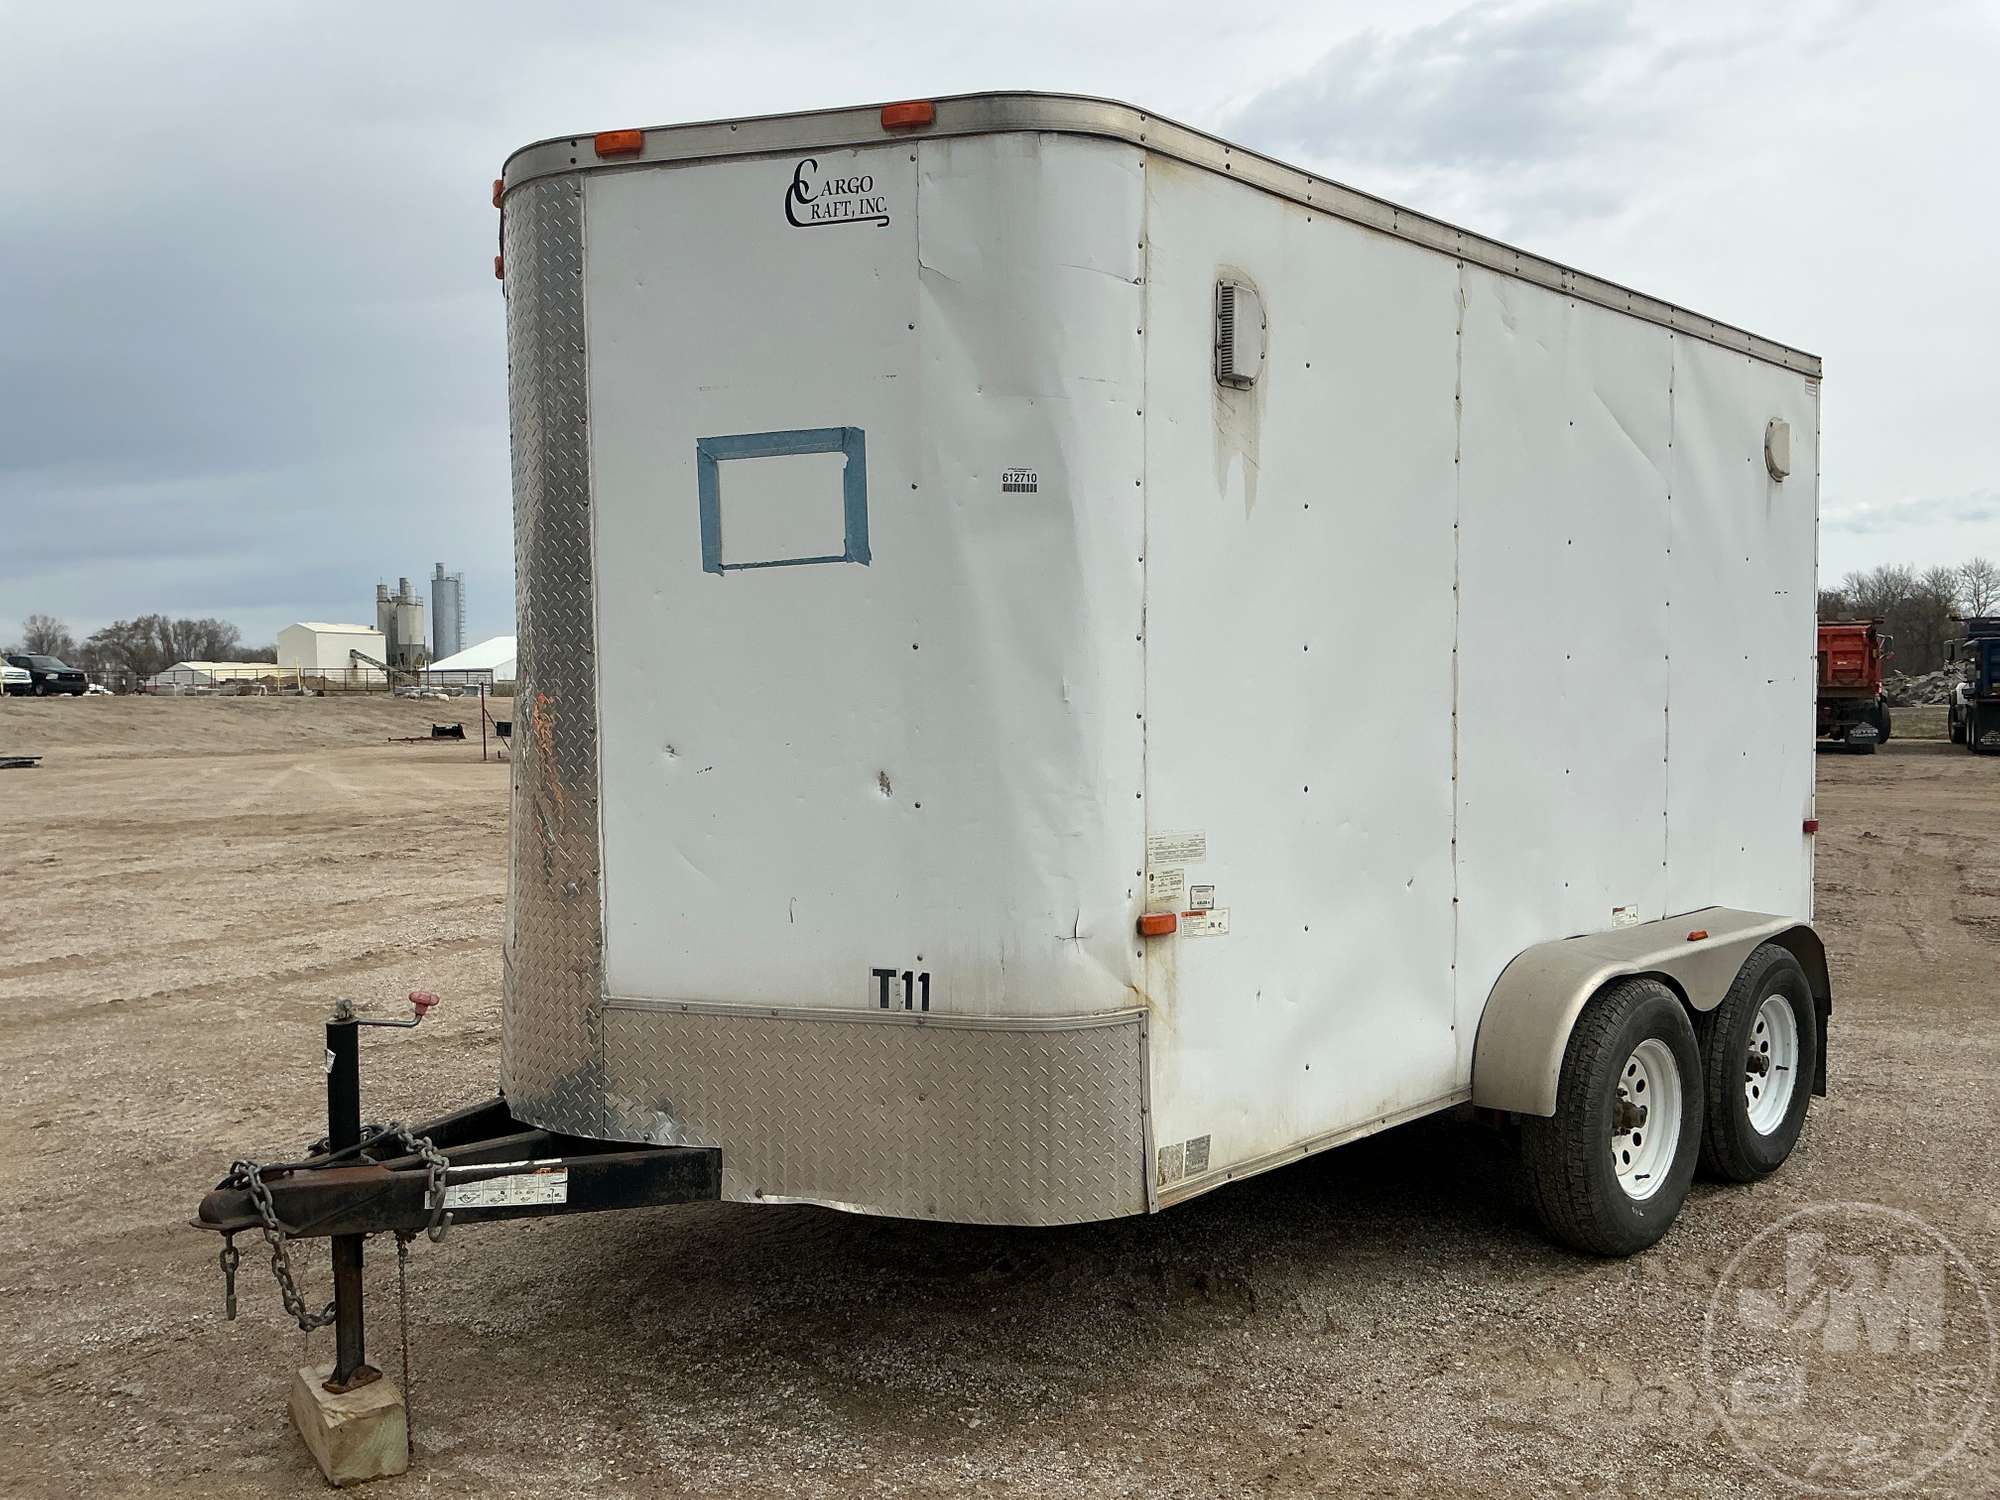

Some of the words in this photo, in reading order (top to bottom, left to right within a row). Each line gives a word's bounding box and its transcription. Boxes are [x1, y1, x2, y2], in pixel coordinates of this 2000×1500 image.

[794, 158, 874, 204] CARGO
[859, 196, 888, 215] INC.
[1002, 472, 1037, 483] 612710
[872, 968, 930, 1011] T11
